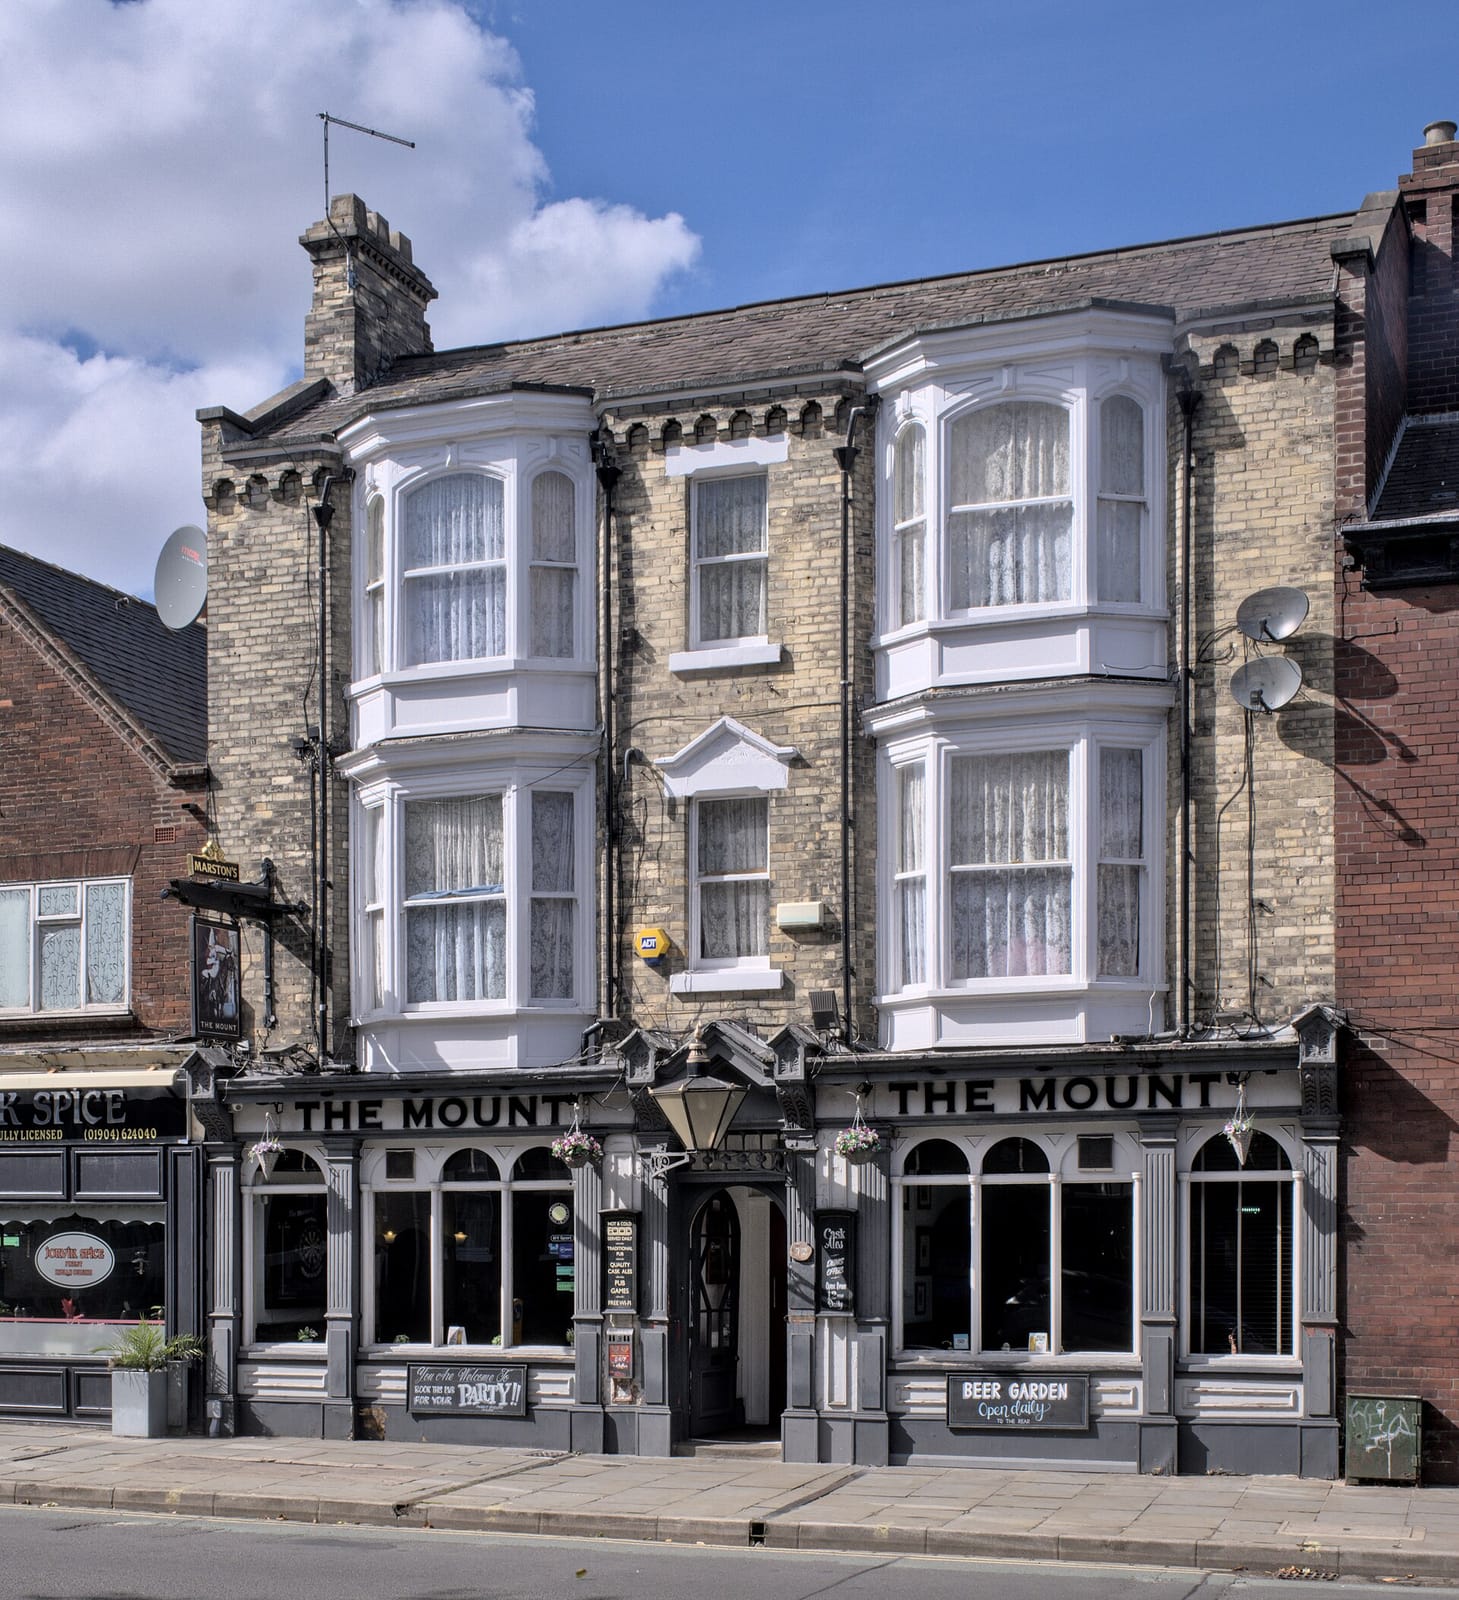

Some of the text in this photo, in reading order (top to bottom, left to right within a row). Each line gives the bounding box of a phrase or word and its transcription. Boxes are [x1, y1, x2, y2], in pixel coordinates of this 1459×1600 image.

[194, 860, 238, 878] MARSTON'S
[641, 938, 656, 948] ADT
[201, 1021, 237, 1031] THE MOUNT
[888, 1074, 1221, 1115] THE MOUNT
[0, 1092, 22, 1125] K
[295, 1095, 568, 1131] THE MOUNT
[21, 1129, 63, 1140] LICENSED
[84, 1127, 157, 1141] (01904) 624040
[607, 1227, 632, 1236] FOOD
[823, 1227, 846, 1240] Cask
[614, 1279, 626, 1287] PUB
[416, 1366, 434, 1383] You
[436, 1367, 454, 1381] Are
[457, 1368, 495, 1383] Welcome
[458, 1382, 521, 1406] PARTY!!
[962, 1381, 1068, 1401] BEER GARDEN
[413, 1395, 453, 1405] FOR YOUR
[978, 1400, 1051, 1422] Open daily
